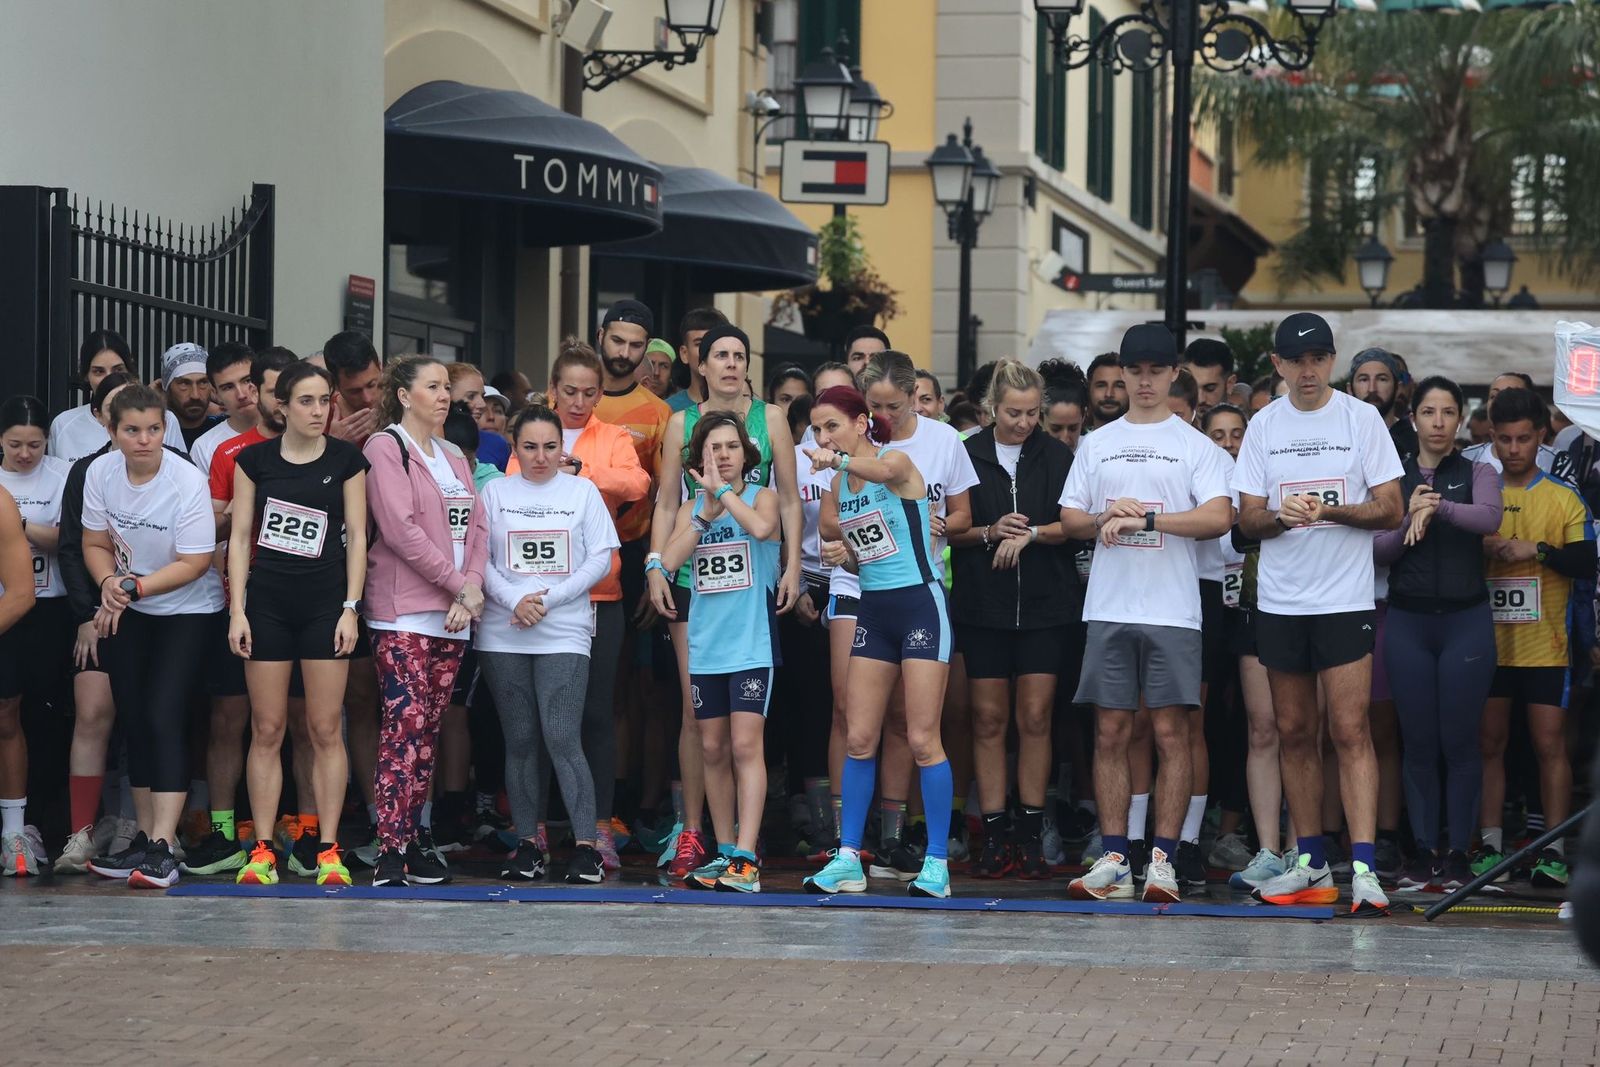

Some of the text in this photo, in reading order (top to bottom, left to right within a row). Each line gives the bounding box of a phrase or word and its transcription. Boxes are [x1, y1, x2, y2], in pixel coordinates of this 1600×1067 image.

[513, 153, 639, 206] TOMMY
[1112, 277, 1144, 289] Guest
[267, 512, 319, 540] 226
[847, 523, 884, 548] 163
[522, 541, 556, 560] 95
[698, 554, 744, 577] 283
[1225, 573, 1244, 592] 2
[1494, 589, 1525, 608] 90
